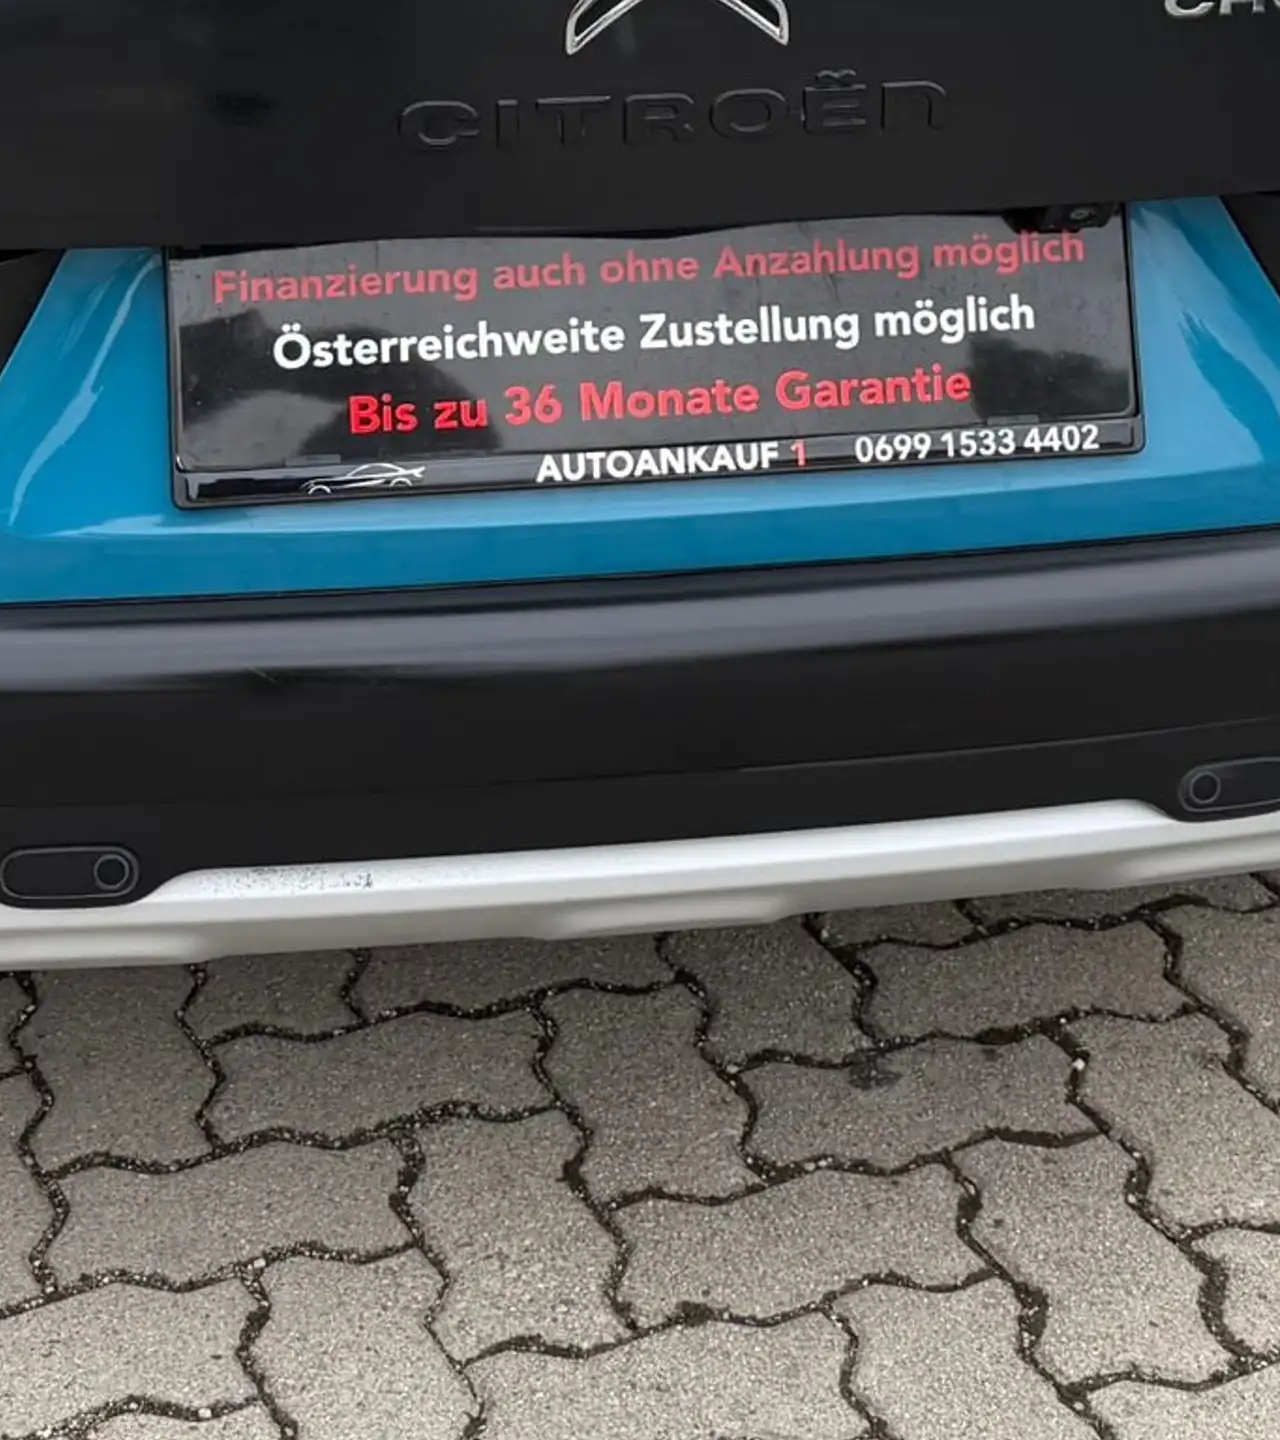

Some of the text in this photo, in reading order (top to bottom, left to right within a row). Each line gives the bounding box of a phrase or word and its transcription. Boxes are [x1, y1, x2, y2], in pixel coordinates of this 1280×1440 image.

[213, 229, 1086, 305] Finanzierung auch ohne Anzahlung möglich
[273, 293, 1036, 370] Österreichweite Zustellung möglich
[348, 362, 972, 435] Bis zu 36 Monate Garantie
[535, 423, 1100, 484] AUTOANKAUF 1 0699 1533 4402
